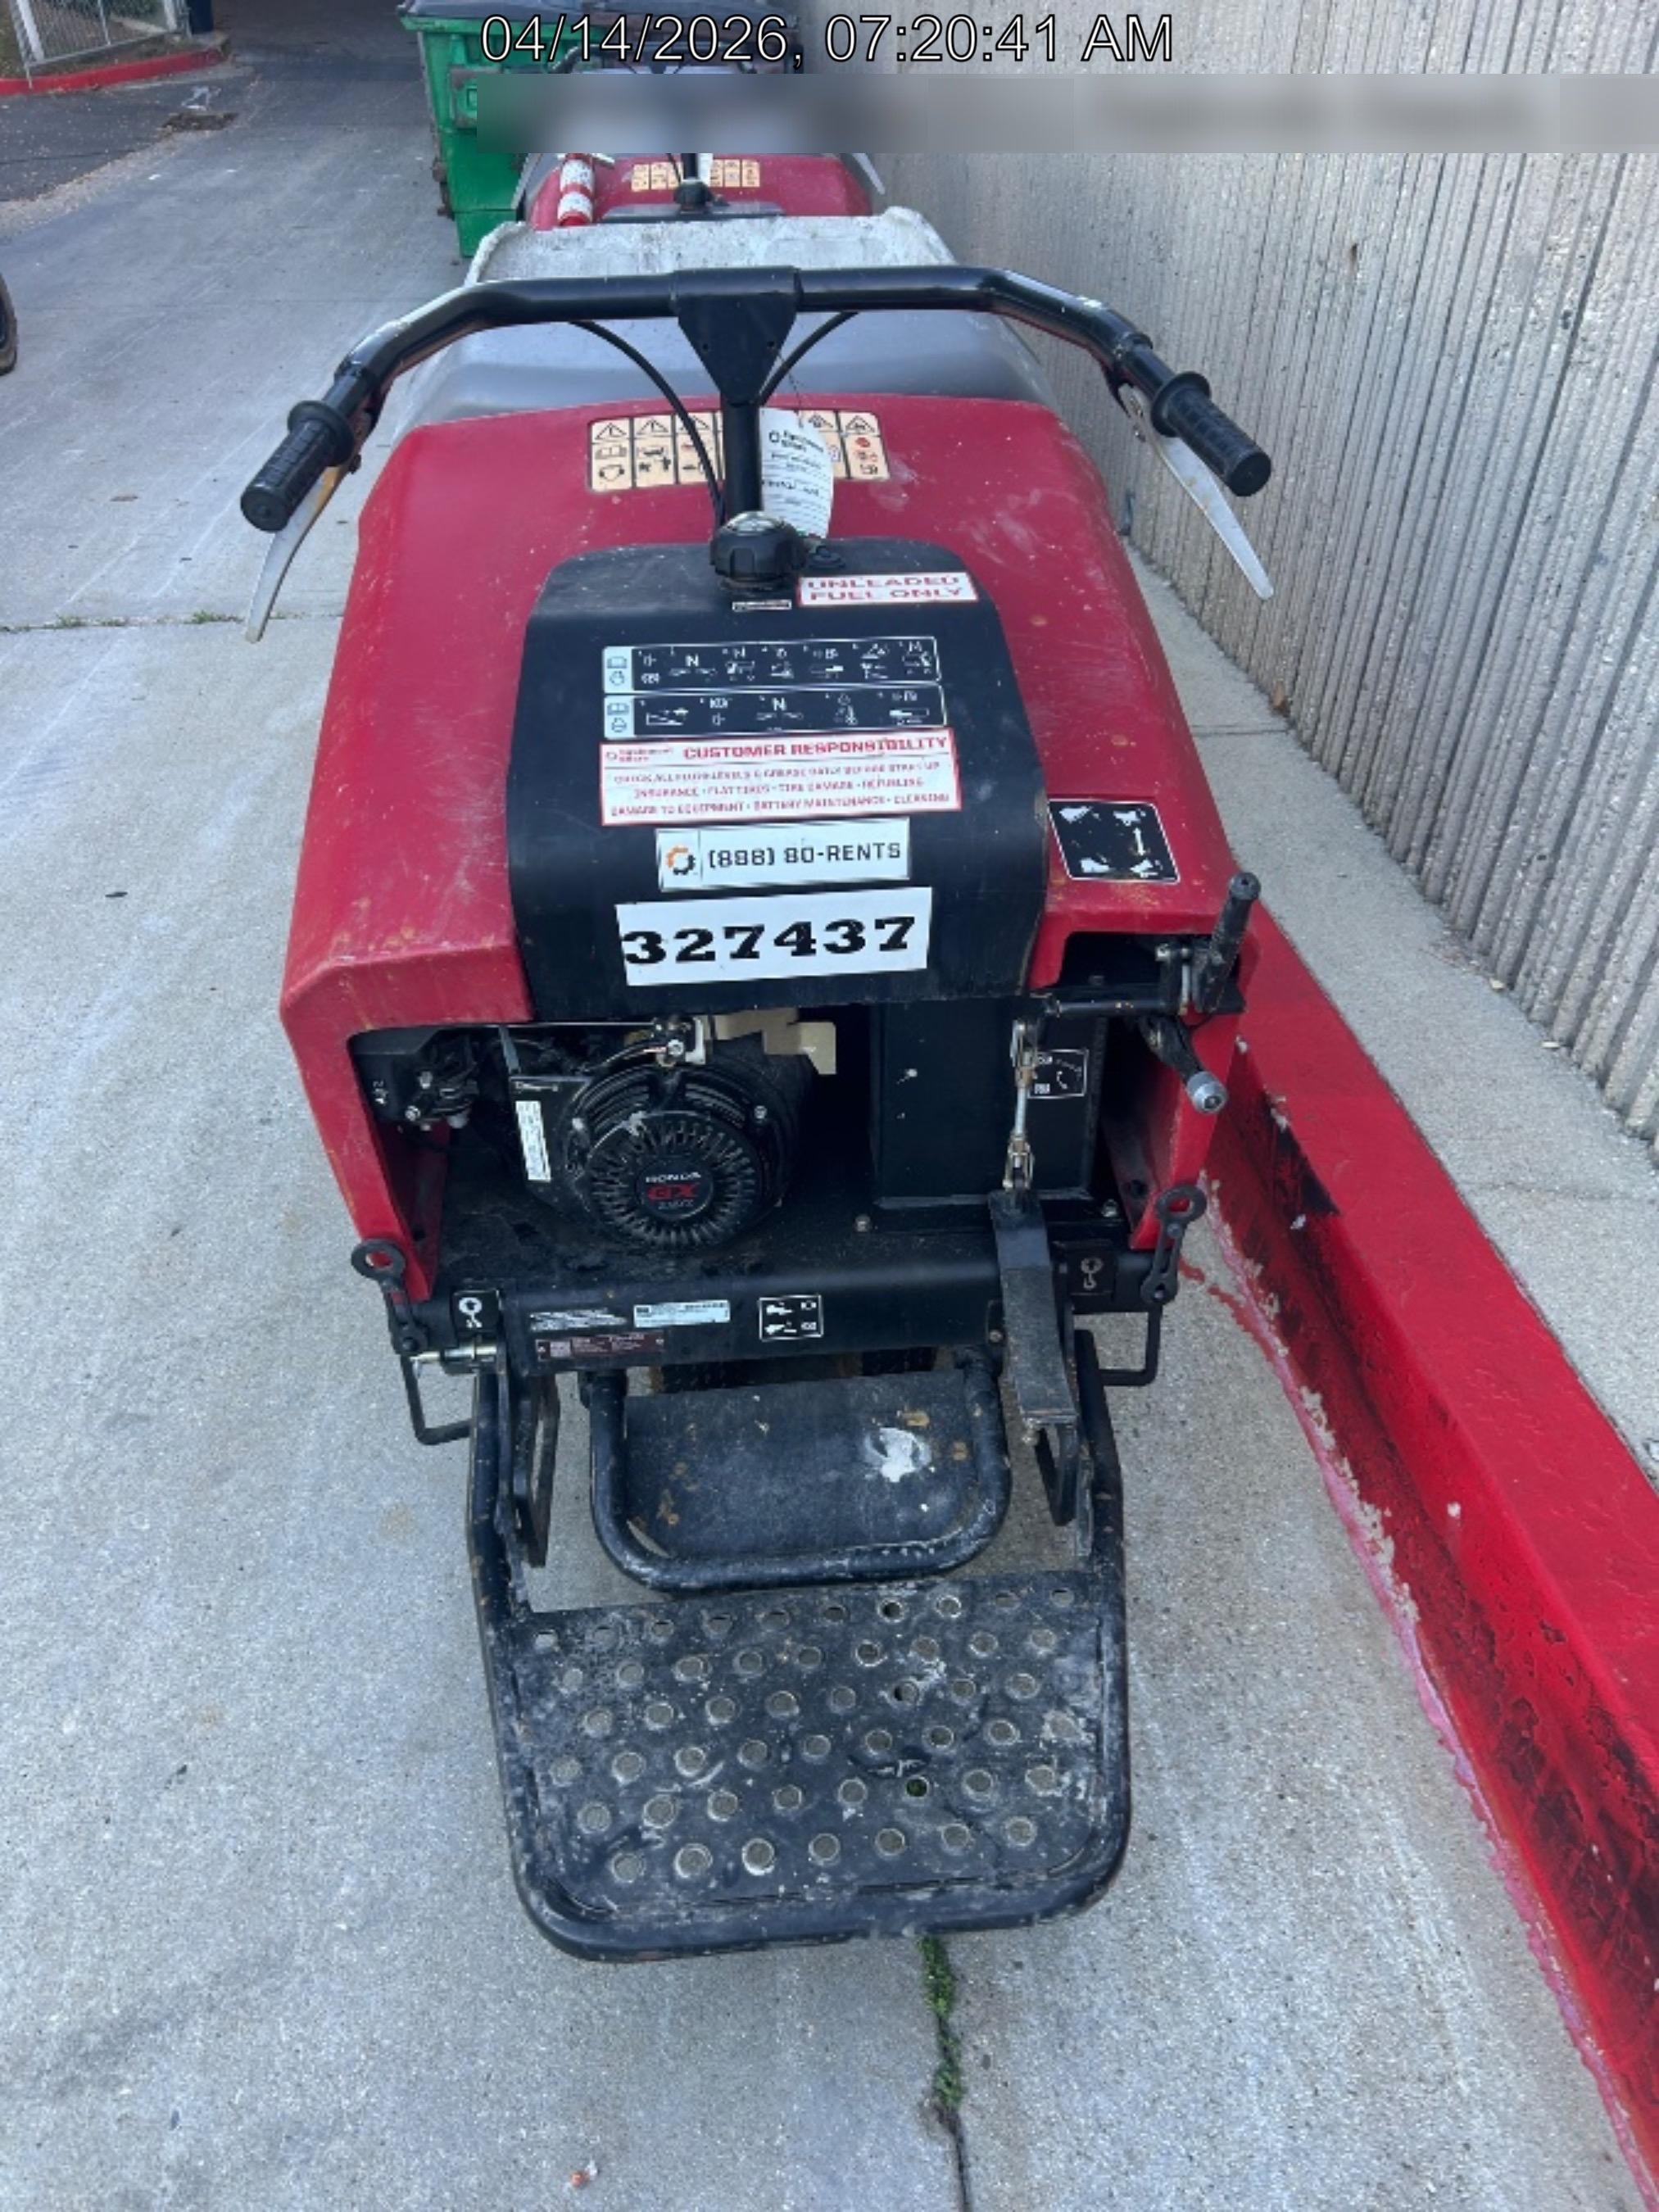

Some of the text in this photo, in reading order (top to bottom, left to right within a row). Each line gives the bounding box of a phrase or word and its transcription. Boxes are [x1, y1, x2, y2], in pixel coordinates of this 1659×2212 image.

[807, 576, 960, 589] UNLEADED
[809, 587, 962, 601] FUEL ONLY
[682, 744, 786, 759] CUSTOMER
[791, 737, 948, 755] RESPONSIBILITY
[708, 841, 902, 869] (888) 80-RENTS
[622, 915, 916, 965] 327437
[645, 1171, 702, 1184] HONDA
[646, 1182, 700, 1201] GX
